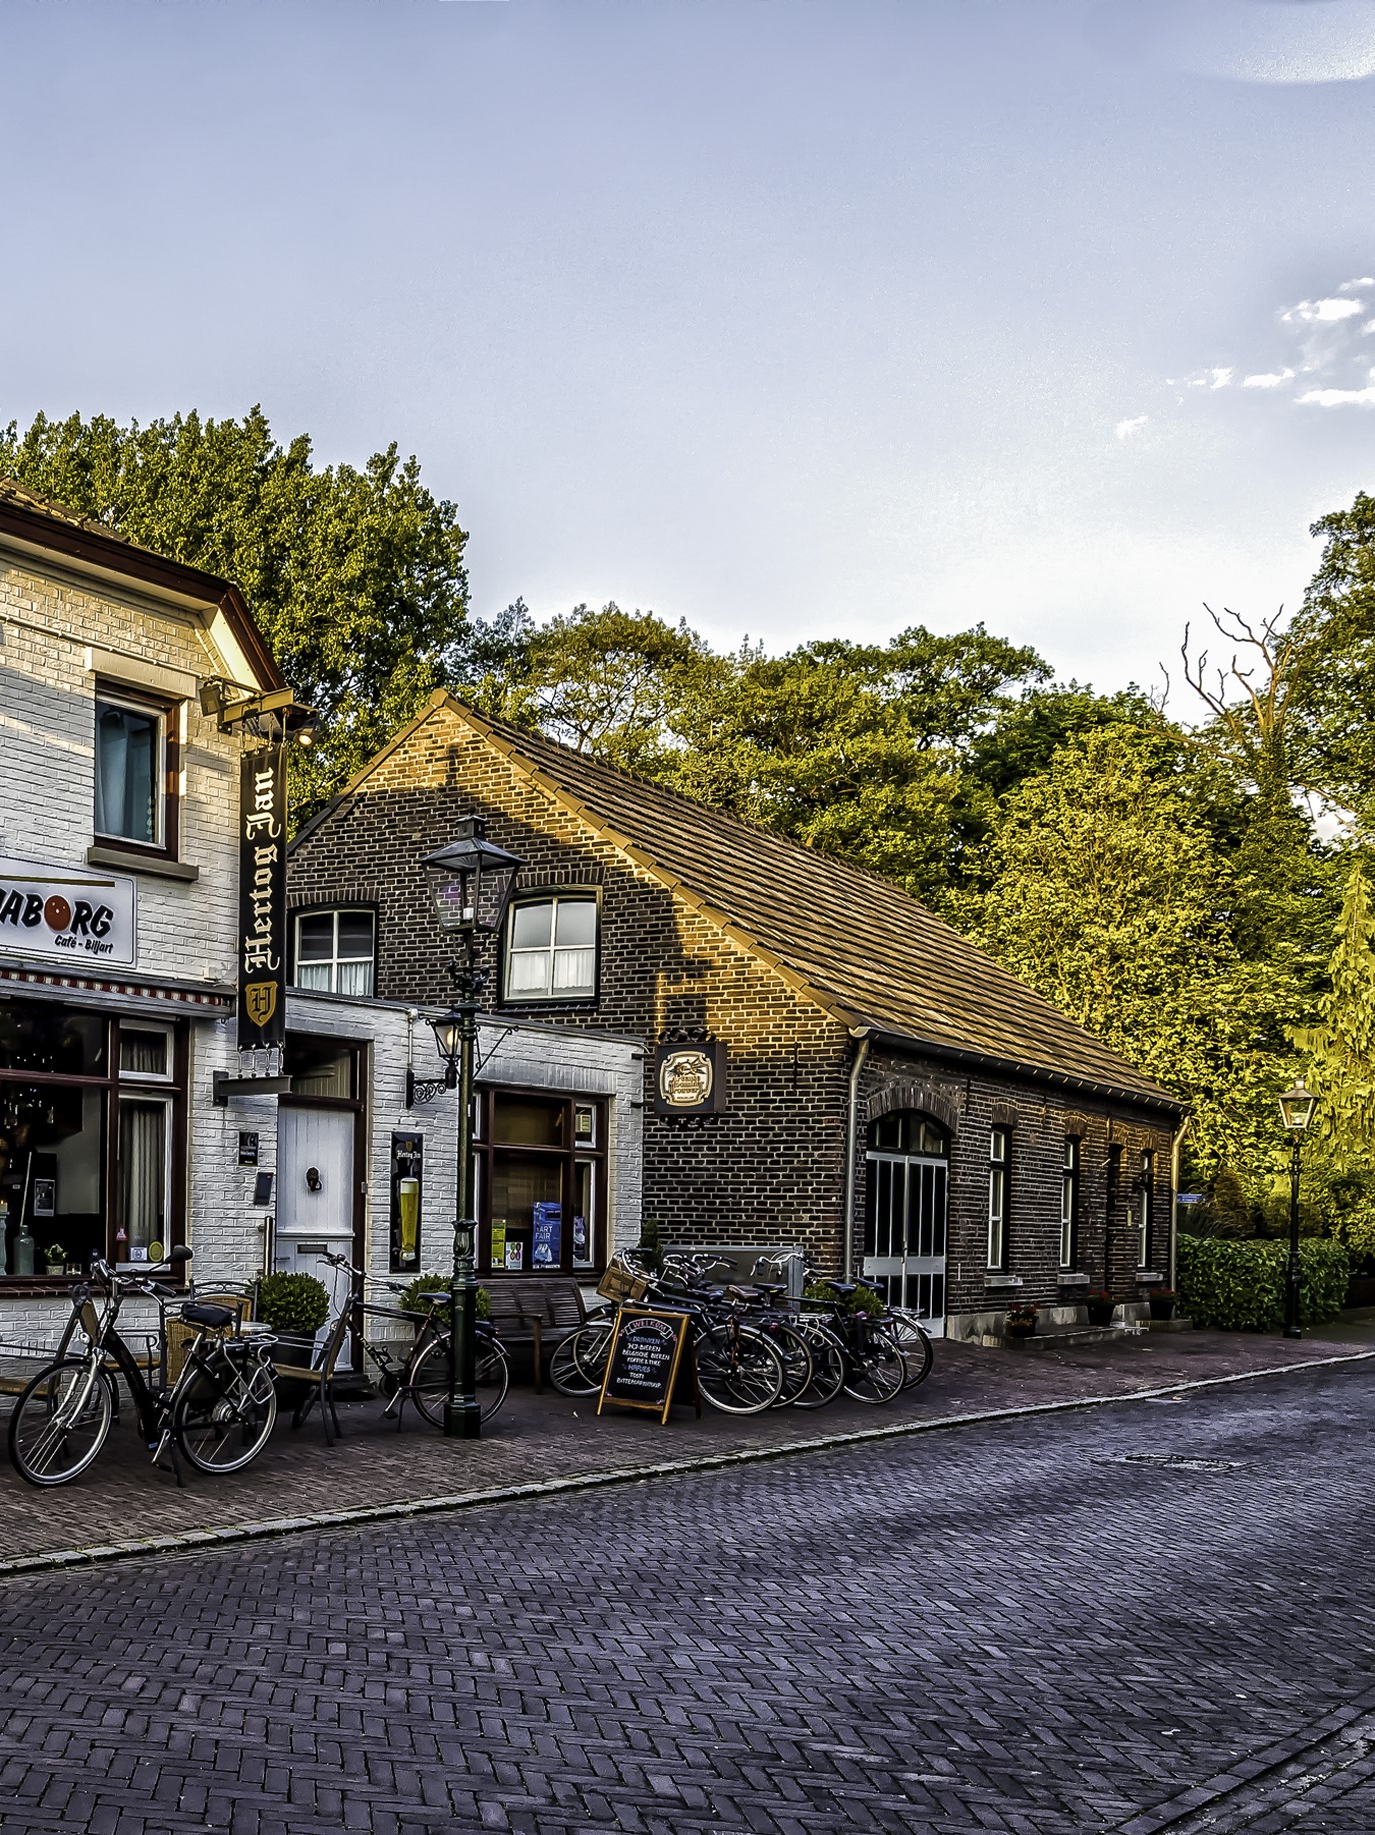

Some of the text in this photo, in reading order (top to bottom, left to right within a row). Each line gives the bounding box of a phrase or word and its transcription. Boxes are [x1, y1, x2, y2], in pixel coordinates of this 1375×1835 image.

[244, 767, 281, 974] Hertog Jan
[55, 934, 78, 947] Café
[85, 938, 114, 954] Biljart
[535, 1232, 551, 1240] FAIR
[539, 1225, 553, 1233] ART
